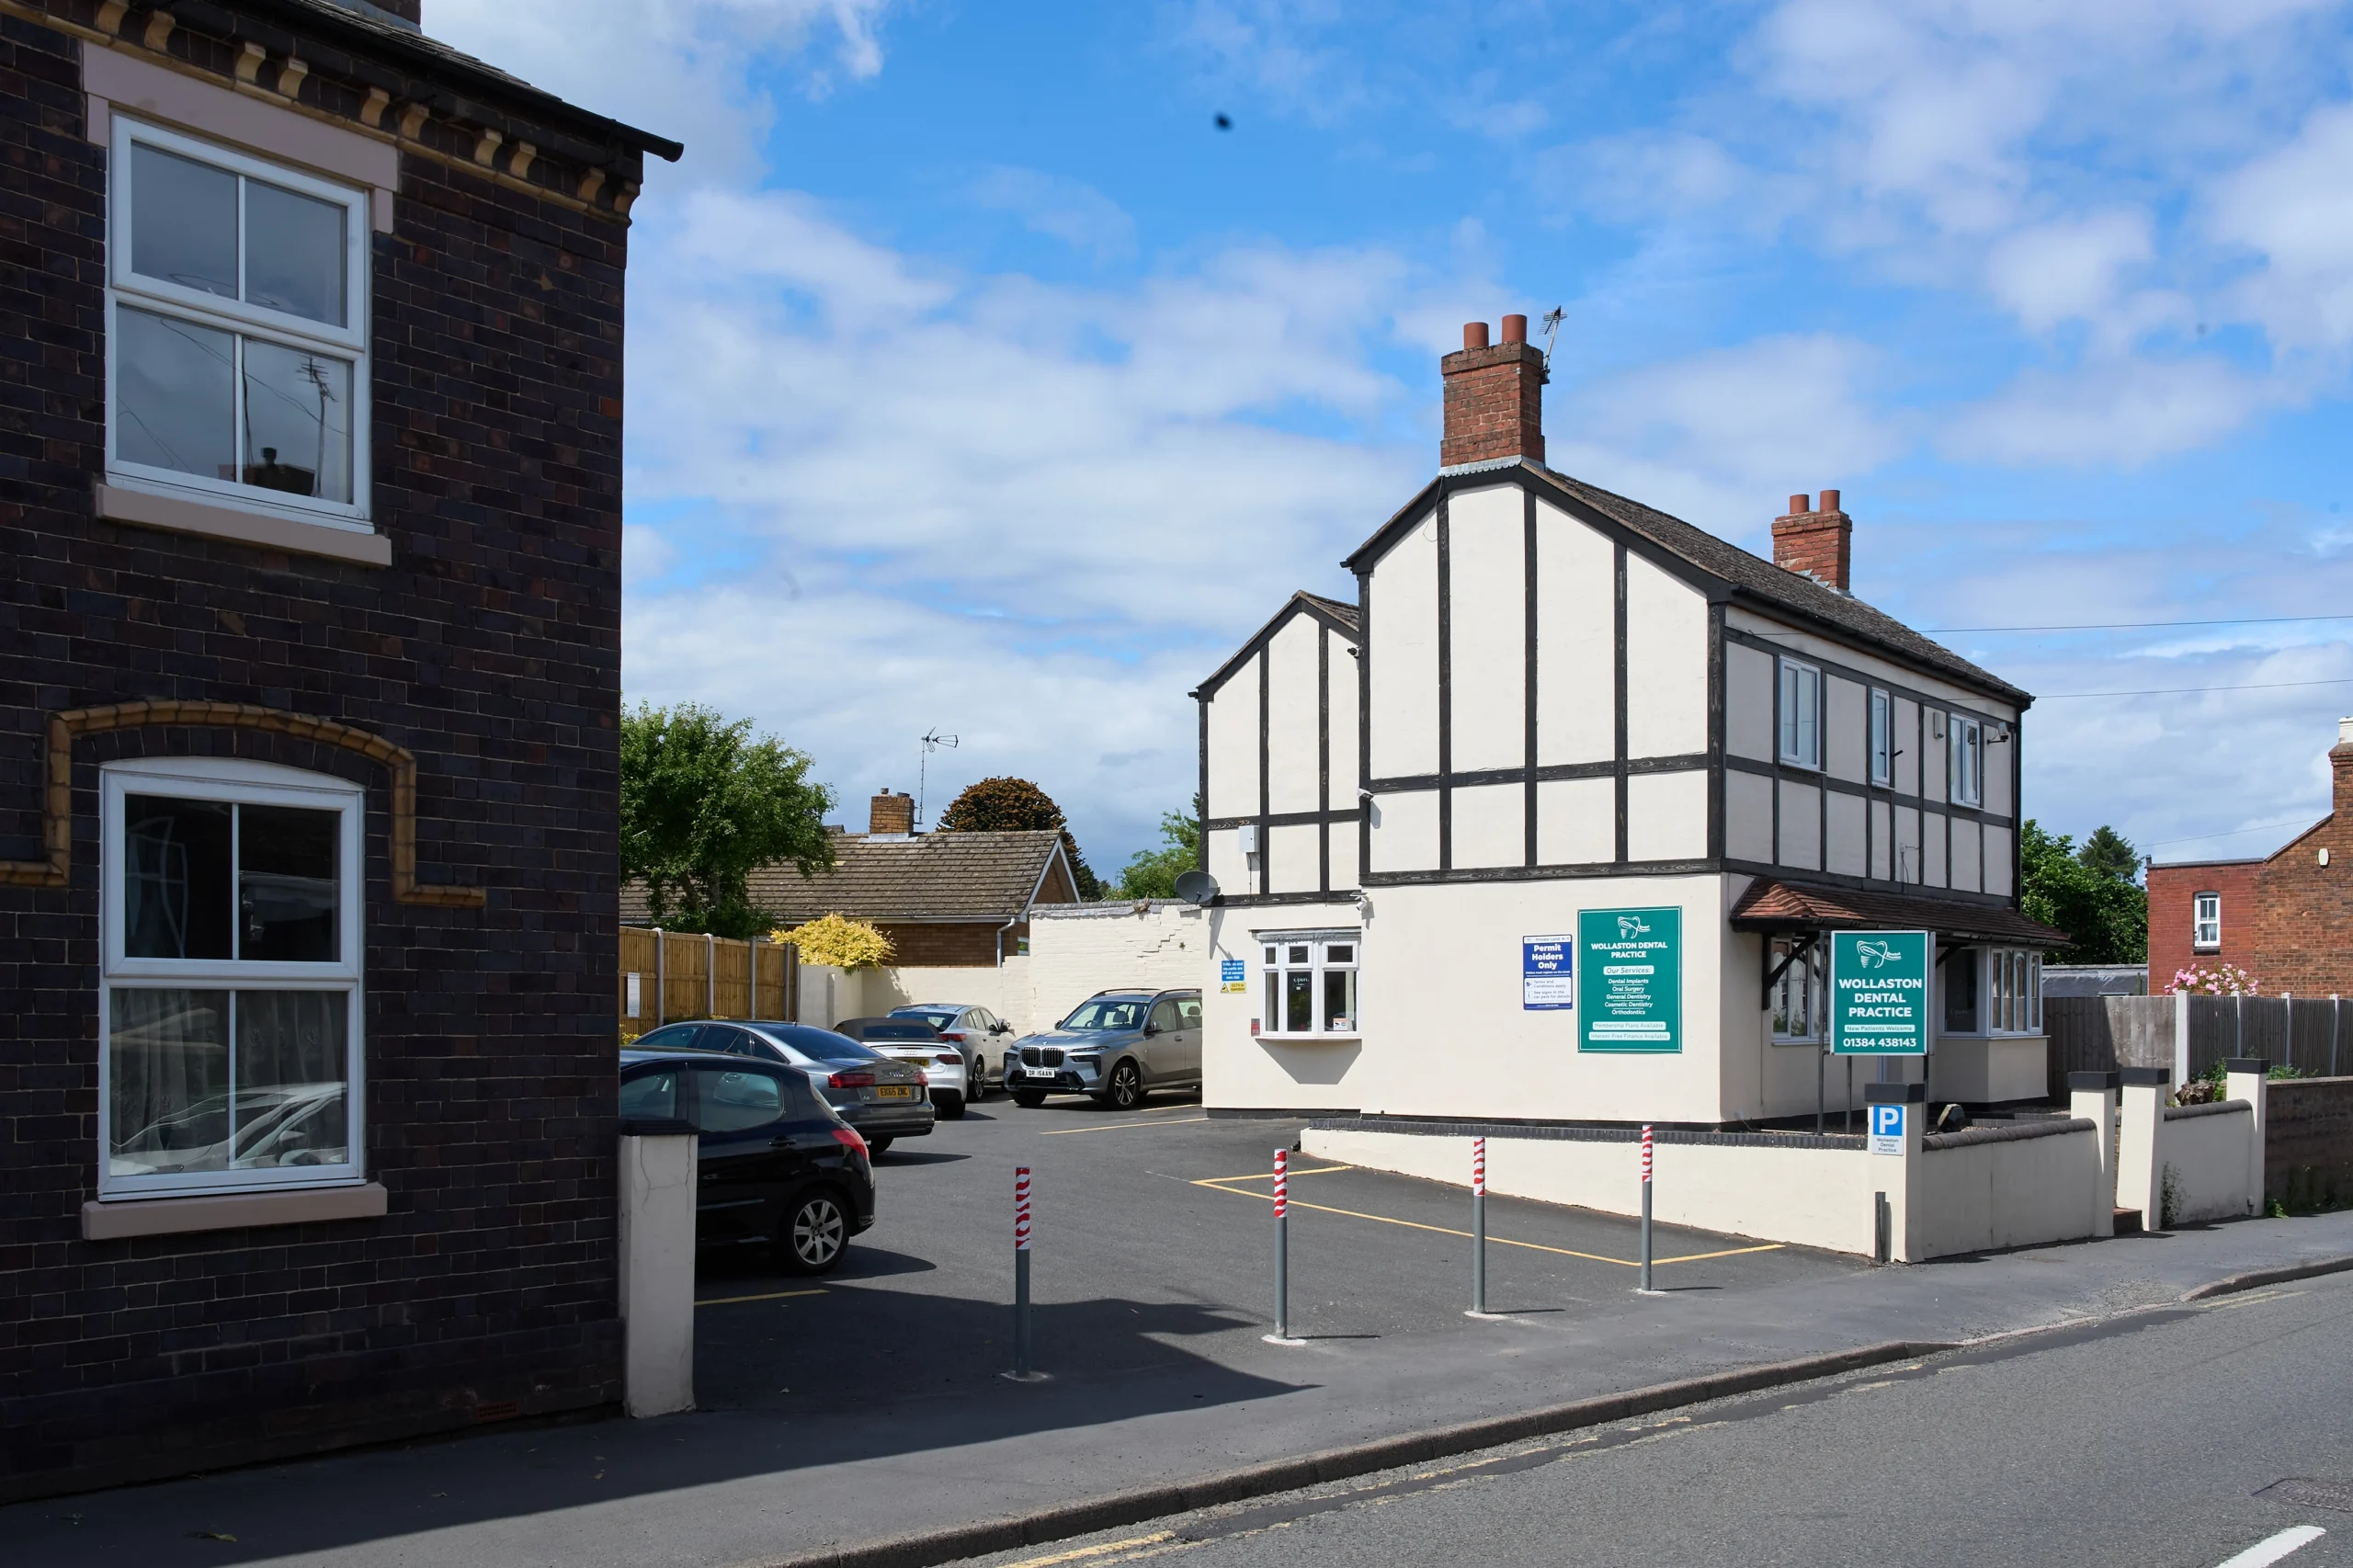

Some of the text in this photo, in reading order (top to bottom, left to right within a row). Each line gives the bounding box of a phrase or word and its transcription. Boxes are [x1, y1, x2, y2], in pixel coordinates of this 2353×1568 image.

[1533, 943, 1562, 952] Permit
[1591, 942, 1637, 950] WOLLASTON
[1611, 950, 1647, 959] PRACTICE
[1538, 961, 1558, 970] Only
[1838, 978, 1922, 989] WOLLASTON
[1854, 993, 1906, 1003] DENTAL
[1848, 1006, 1913, 1017] PRACTICE
[1843, 1038, 1917, 1047] 01384 438143
[1880, 1108, 1899, 1134] P
